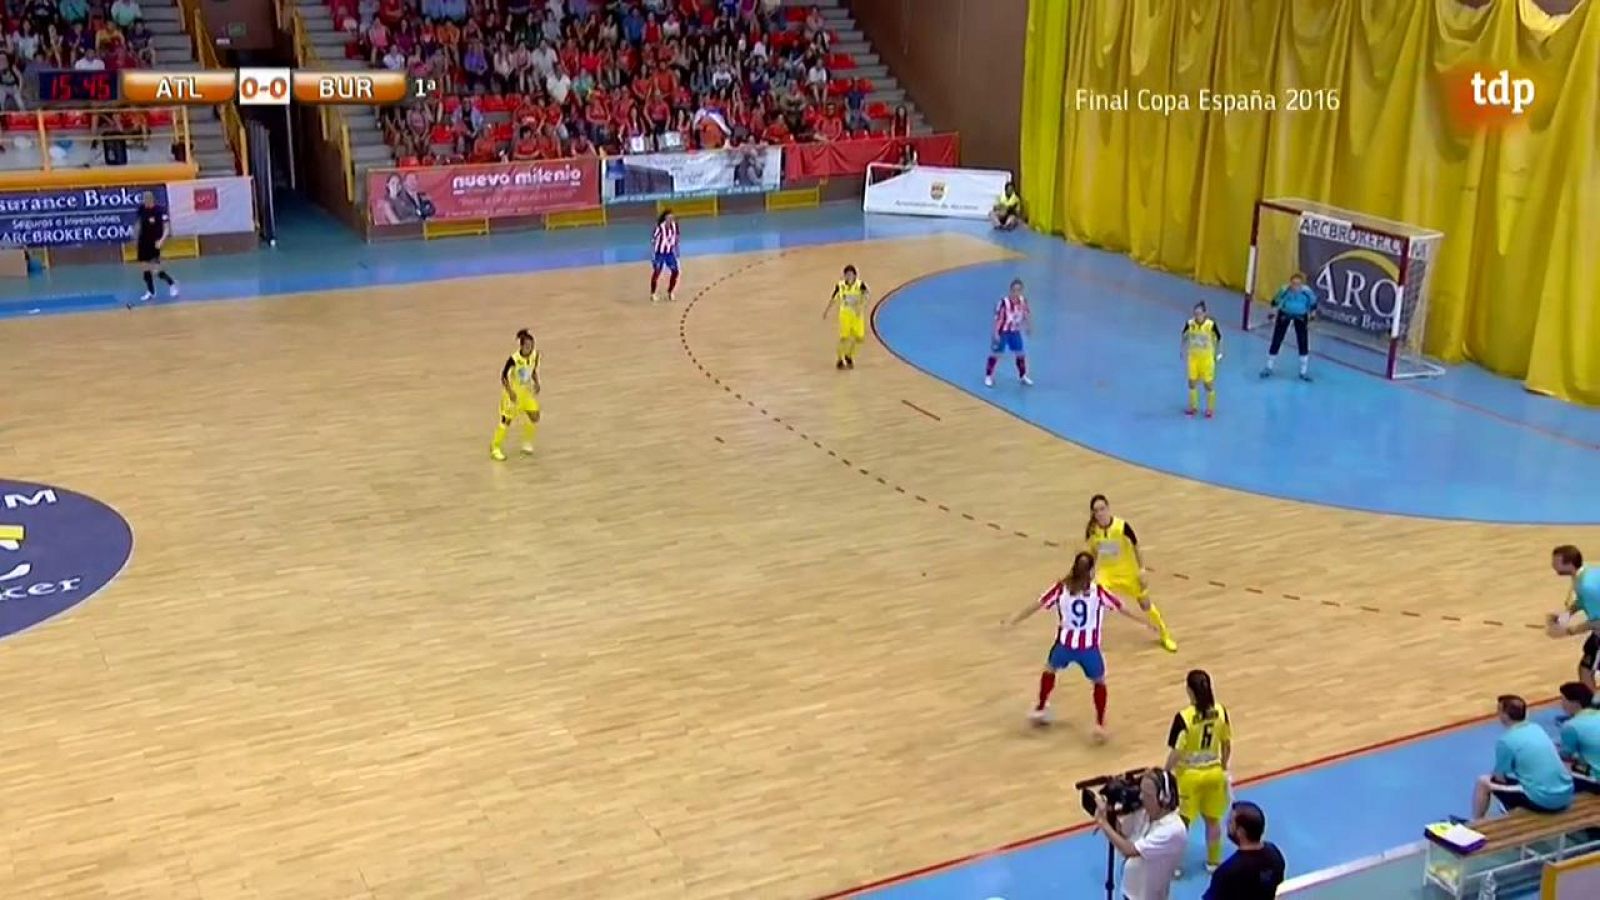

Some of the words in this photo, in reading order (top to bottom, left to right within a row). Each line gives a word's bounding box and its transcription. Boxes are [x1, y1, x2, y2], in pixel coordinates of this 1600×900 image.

[453, 172, 510, 189] nuevo
[515, 164, 582, 185] milenio
[2, 224, 135, 245] ARCBROKER.COM
[1071, 599, 1088, 628] 9
[1201, 723, 1215, 750] 6
